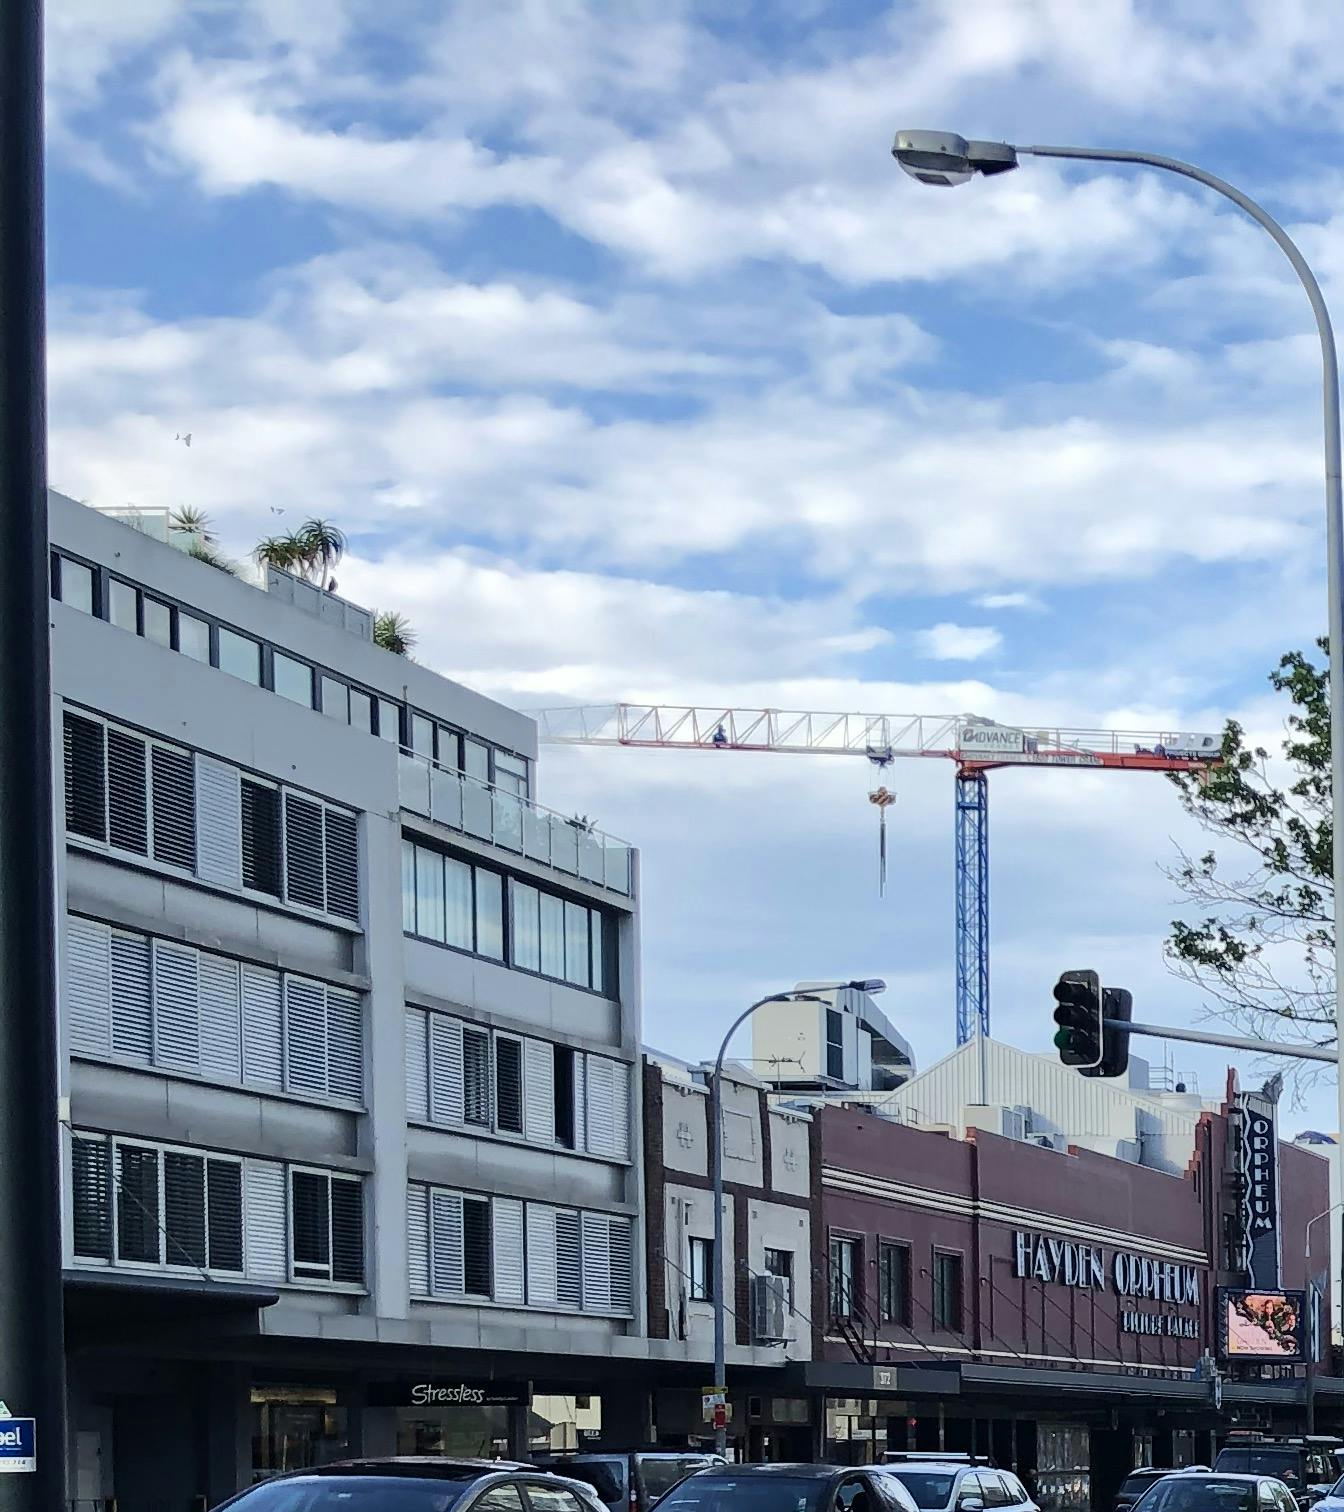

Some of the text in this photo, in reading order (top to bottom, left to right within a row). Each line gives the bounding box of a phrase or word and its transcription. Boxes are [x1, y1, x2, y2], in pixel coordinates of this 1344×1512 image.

[1253, 1119, 1273, 1230] ORPHEUM
[1015, 1231, 1200, 1306] HAYDEN ORPHEUM
[1123, 1311, 1200, 1339] PICTURE PALACE
[411, 1383, 485, 1405] Stressless
